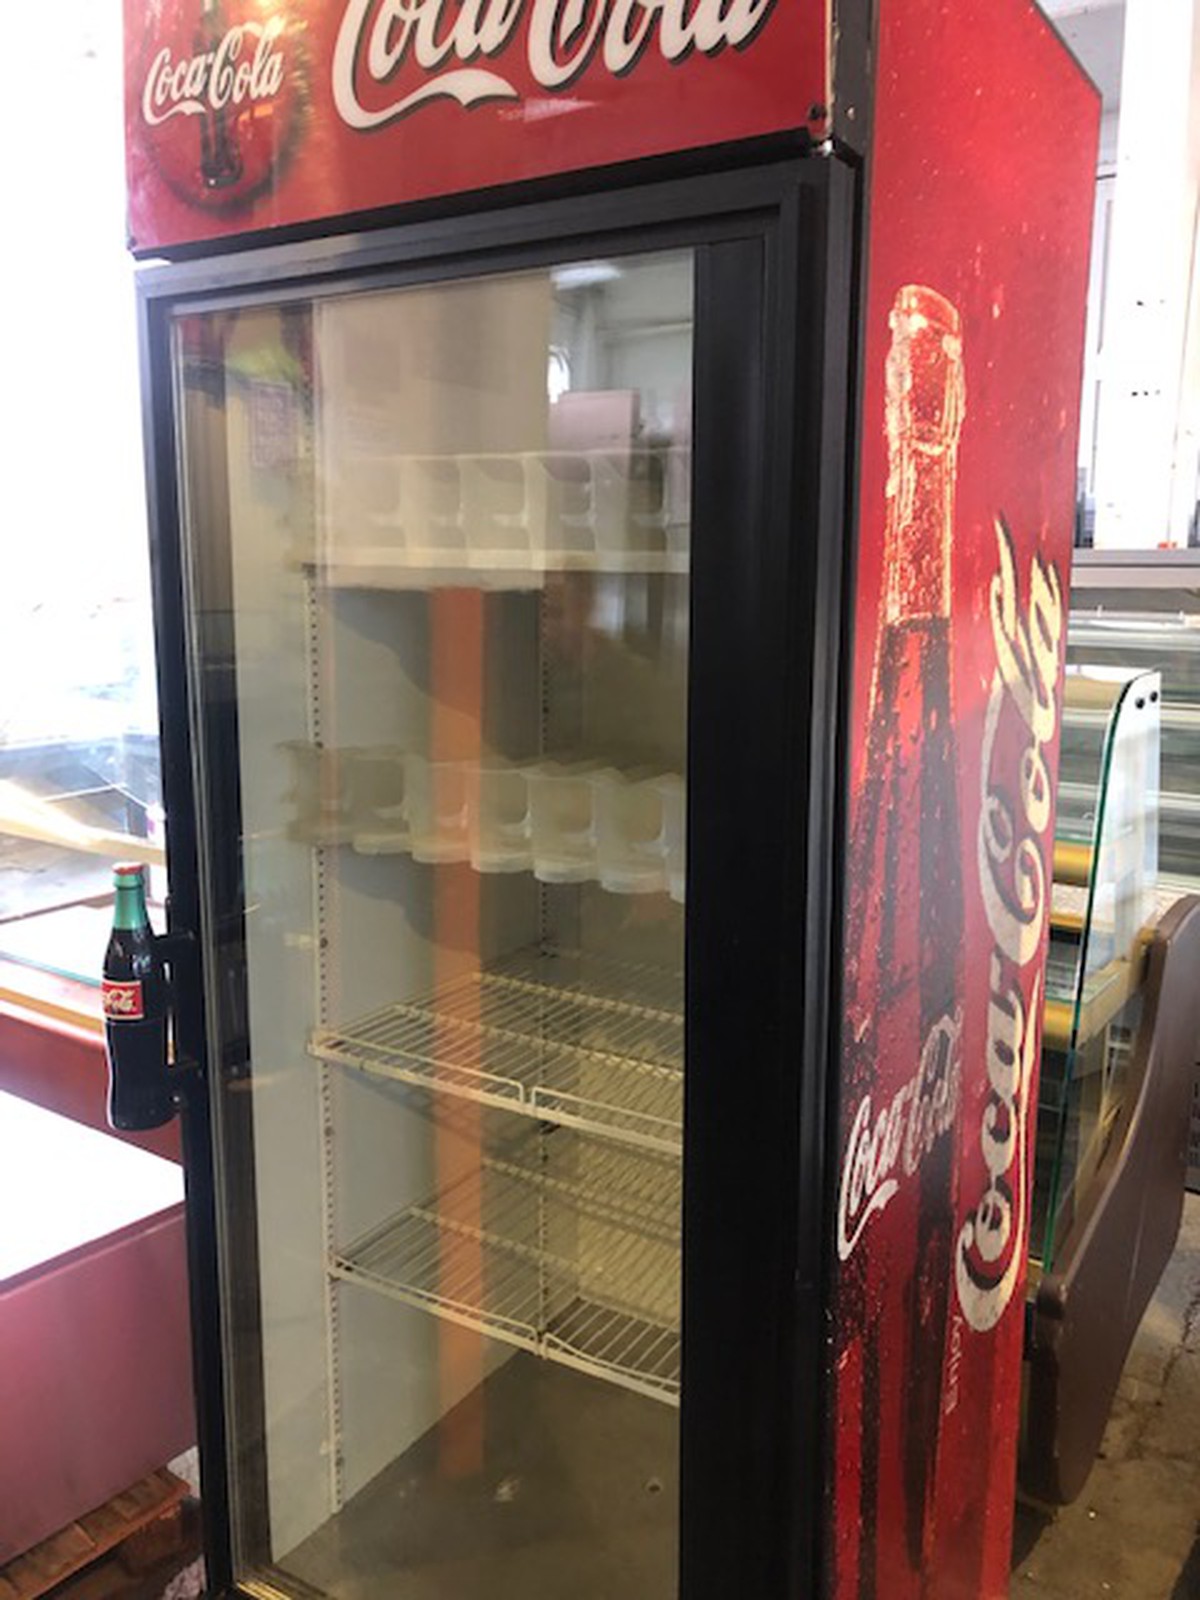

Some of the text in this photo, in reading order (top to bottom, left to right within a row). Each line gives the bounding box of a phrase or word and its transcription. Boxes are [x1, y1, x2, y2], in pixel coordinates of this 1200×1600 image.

[143, 16, 285, 125] Coca-Cola
[956, 518, 1061, 1332] Coca-Cola
[944, 1315, 963, 1415] Enjoy
